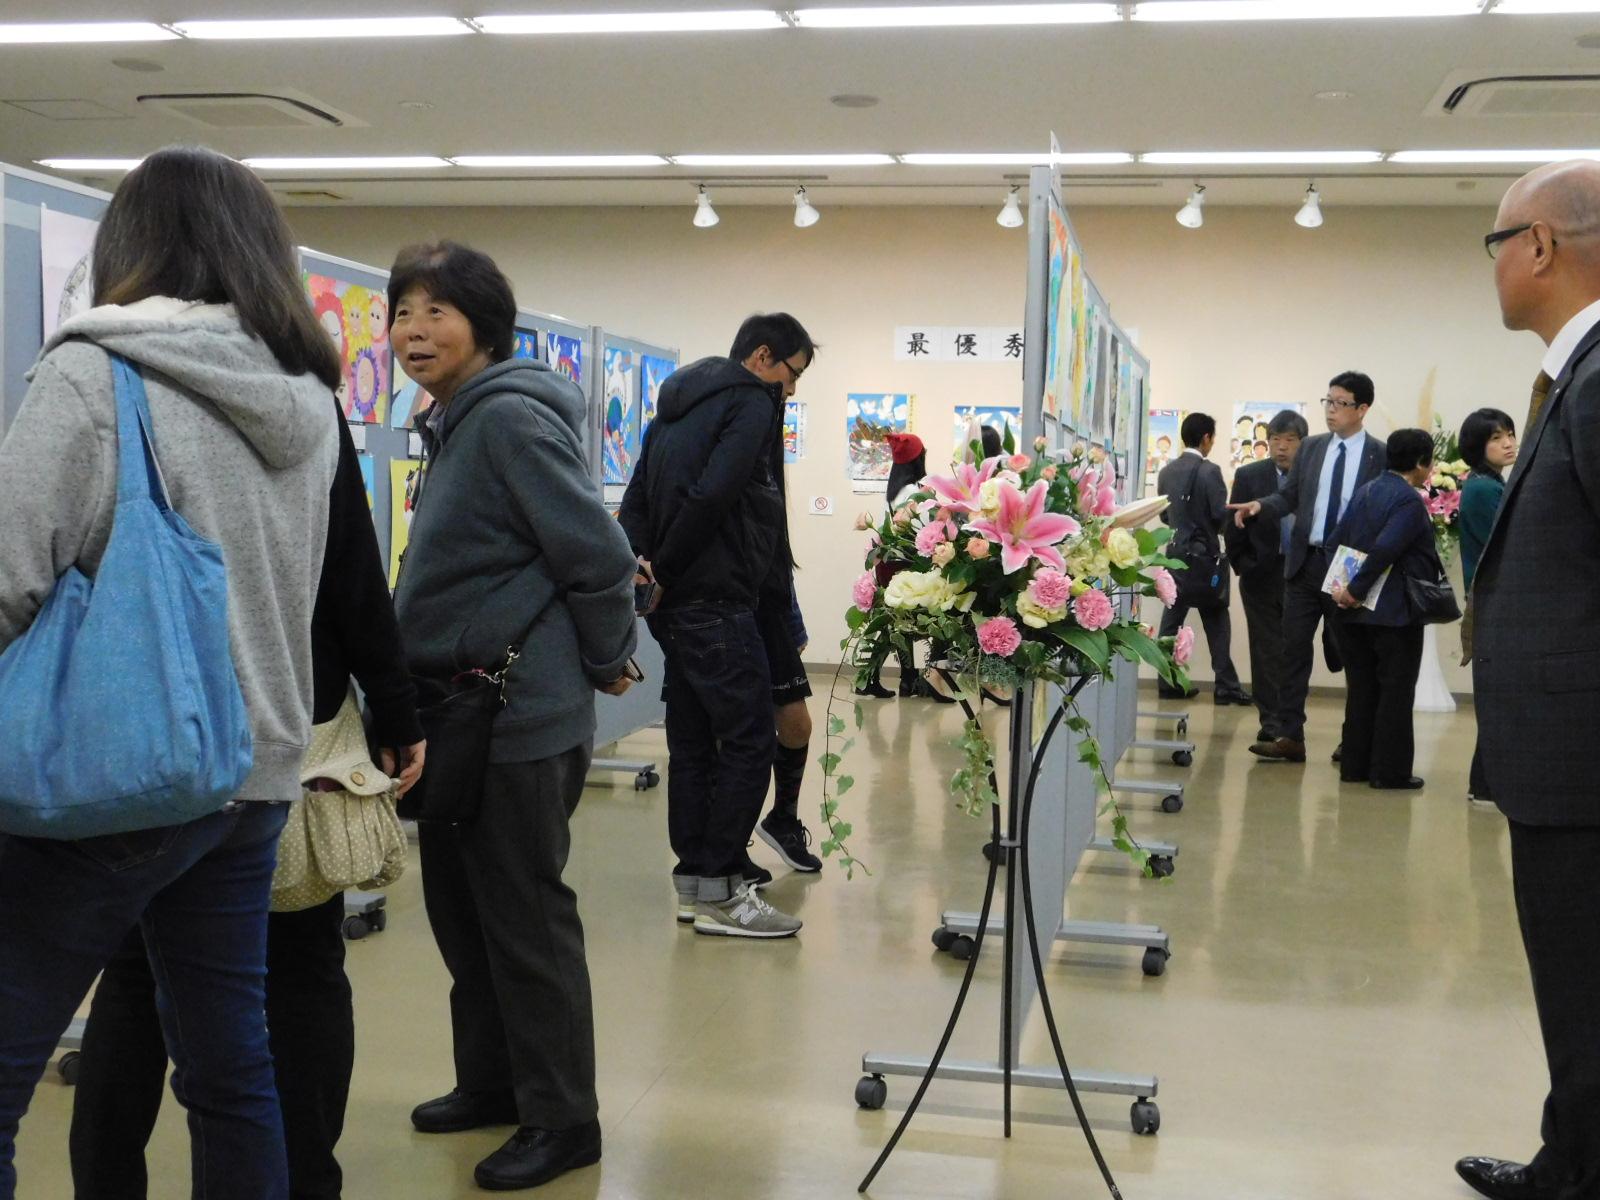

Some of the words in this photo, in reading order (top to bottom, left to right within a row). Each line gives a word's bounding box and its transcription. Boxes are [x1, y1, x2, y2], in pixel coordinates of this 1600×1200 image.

[907, 332, 1024, 358] 最優秀
[729, 902, 760, 926] N
